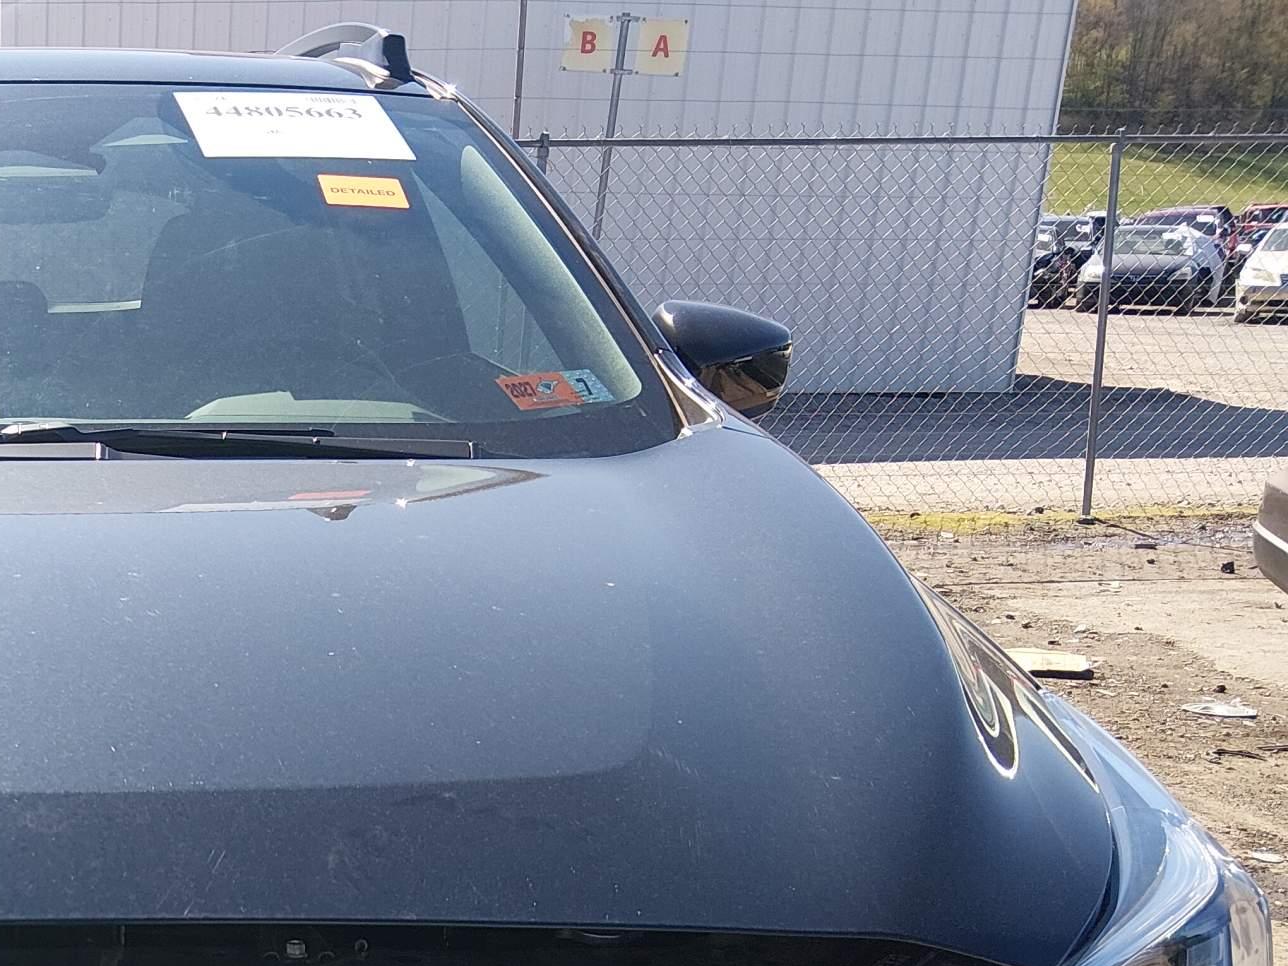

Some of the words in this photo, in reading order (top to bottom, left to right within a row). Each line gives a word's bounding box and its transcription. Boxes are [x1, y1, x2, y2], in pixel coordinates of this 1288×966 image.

[580, 31, 597, 54] B
[651, 34, 670, 58] A
[205, 105, 363, 119] 44805663
[329, 186, 396, 197] DETAILED
[504, 381, 537, 399] 2027
